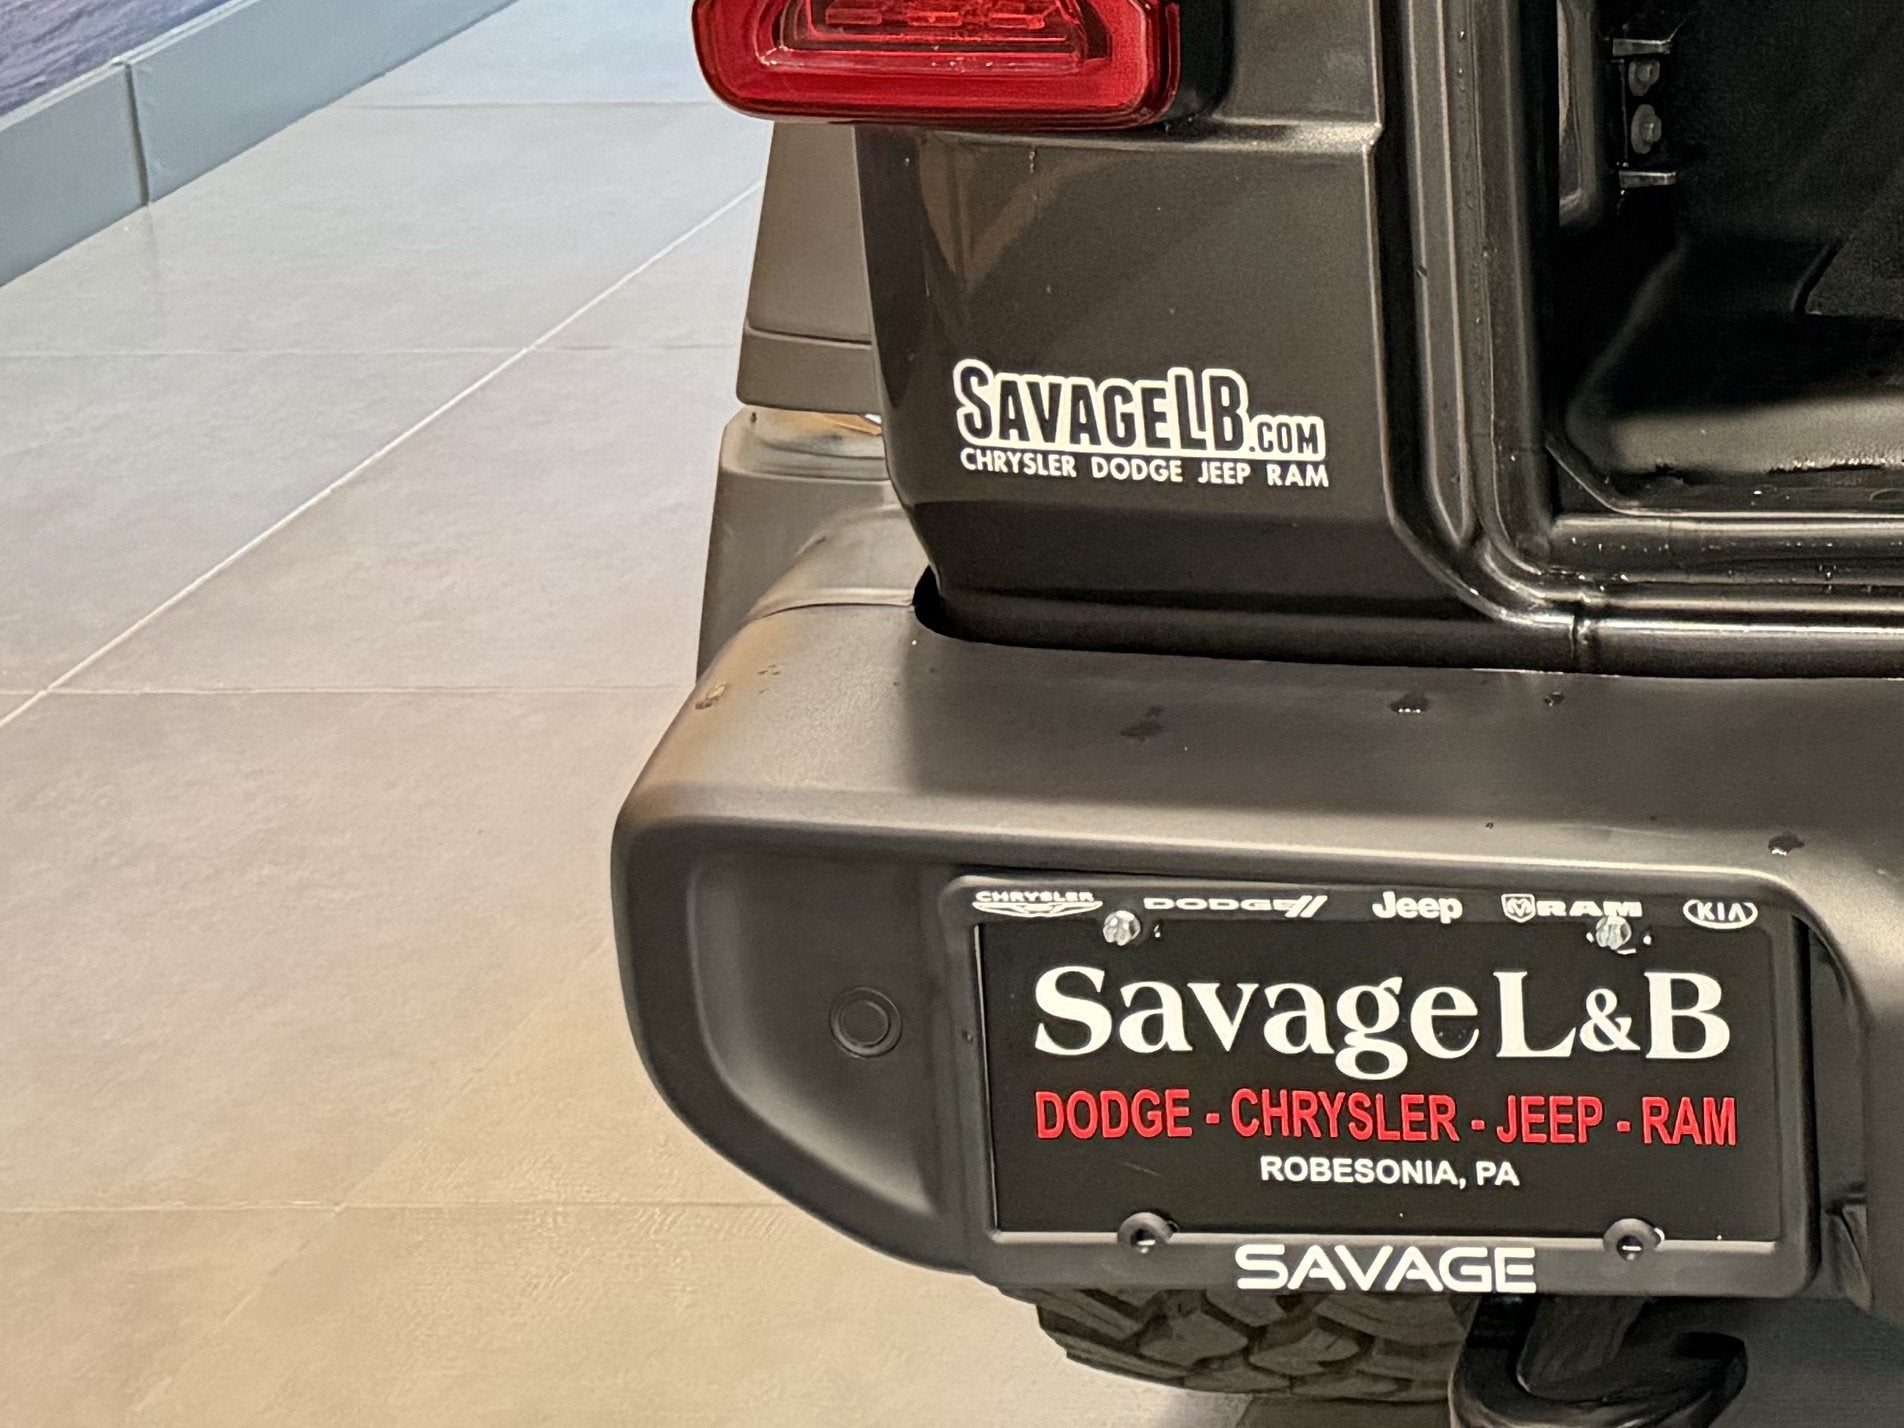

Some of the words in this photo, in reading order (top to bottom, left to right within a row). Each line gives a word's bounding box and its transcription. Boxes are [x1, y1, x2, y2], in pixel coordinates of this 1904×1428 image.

[960, 447, 1077, 478] CHRYSLER
[1090, 455, 1184, 483] DODGE
[1197, 460, 1251, 485] JEEP
[1266, 463, 1330, 488] RAM
[975, 890, 1094, 903] CHRYSLER
[1143, 896, 1294, 912] DODGE
[1371, 890, 1464, 925] Jeep
[1537, 900, 1643, 918] RAM
[1696, 901, 1746, 922] KIA
[1034, 965, 1480, 1081] Savage
[1492, 970, 1731, 1060] L&B
[1035, 1088, 1193, 1139] DODGE
[1231, 1087, 1460, 1142] CHRYSLER
[1496, 1094, 1603, 1144] JEEP
[1641, 1096, 1737, 1146] RAM
[1259, 1155, 1467, 1190] ROBESONIA,
[1475, 1160, 1521, 1187] PA
[1234, 1243, 1537, 1294] SAVAGE
